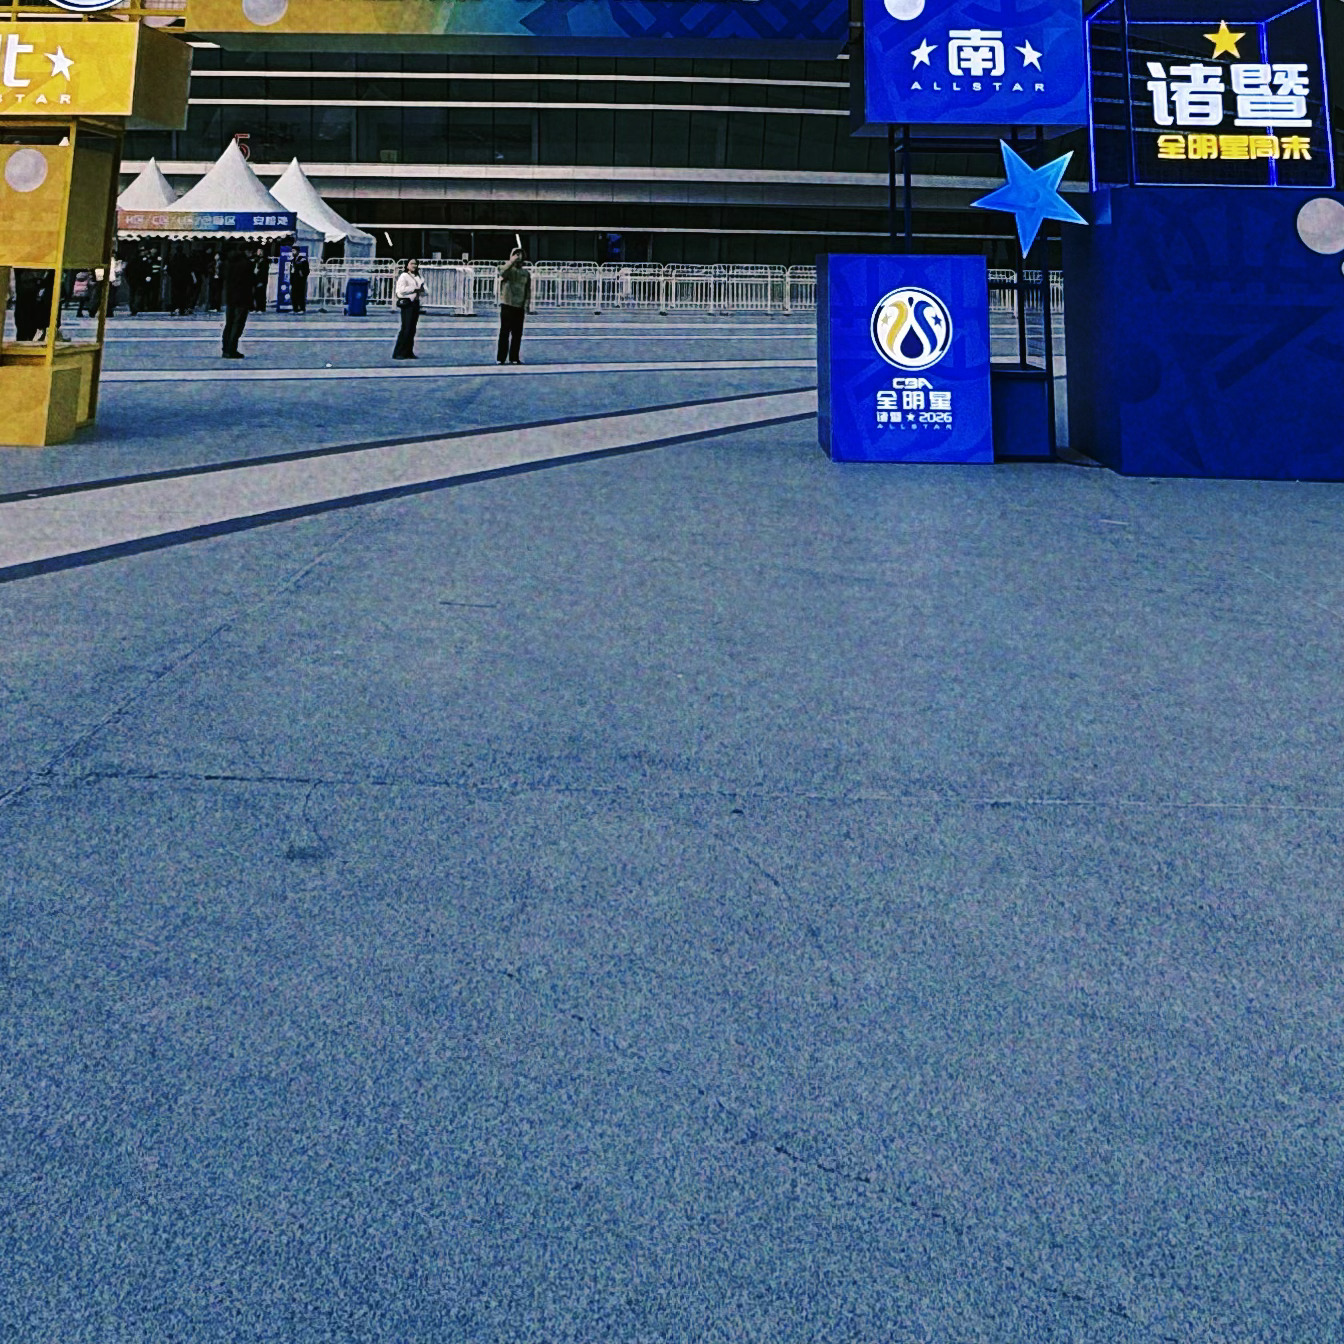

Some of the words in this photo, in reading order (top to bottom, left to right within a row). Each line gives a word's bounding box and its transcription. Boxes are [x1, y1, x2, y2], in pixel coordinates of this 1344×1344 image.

[947, 28, 1006, 77] 南
[1146, 61, 1313, 128] 诸暨
[1157, 134, 1313, 160] 全明星周末
[892, 377, 934, 390] CBA
[876, 390, 952, 410] 全明星
[918, 411, 953, 423] 2026
